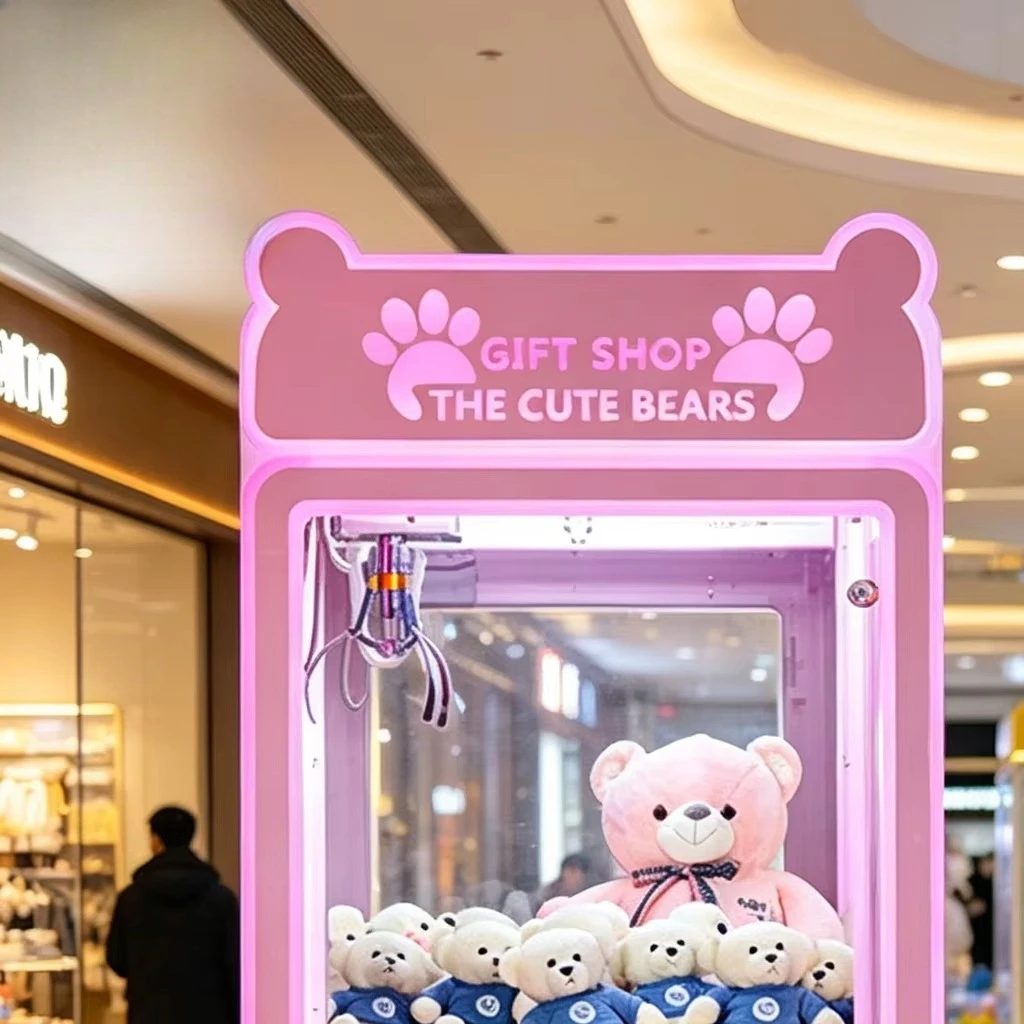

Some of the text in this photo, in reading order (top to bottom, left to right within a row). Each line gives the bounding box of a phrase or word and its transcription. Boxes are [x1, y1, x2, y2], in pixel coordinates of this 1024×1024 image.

[480, 336, 711, 371] GIFT SHOP
[428, 388, 756, 422] THE CUTE BEARS
